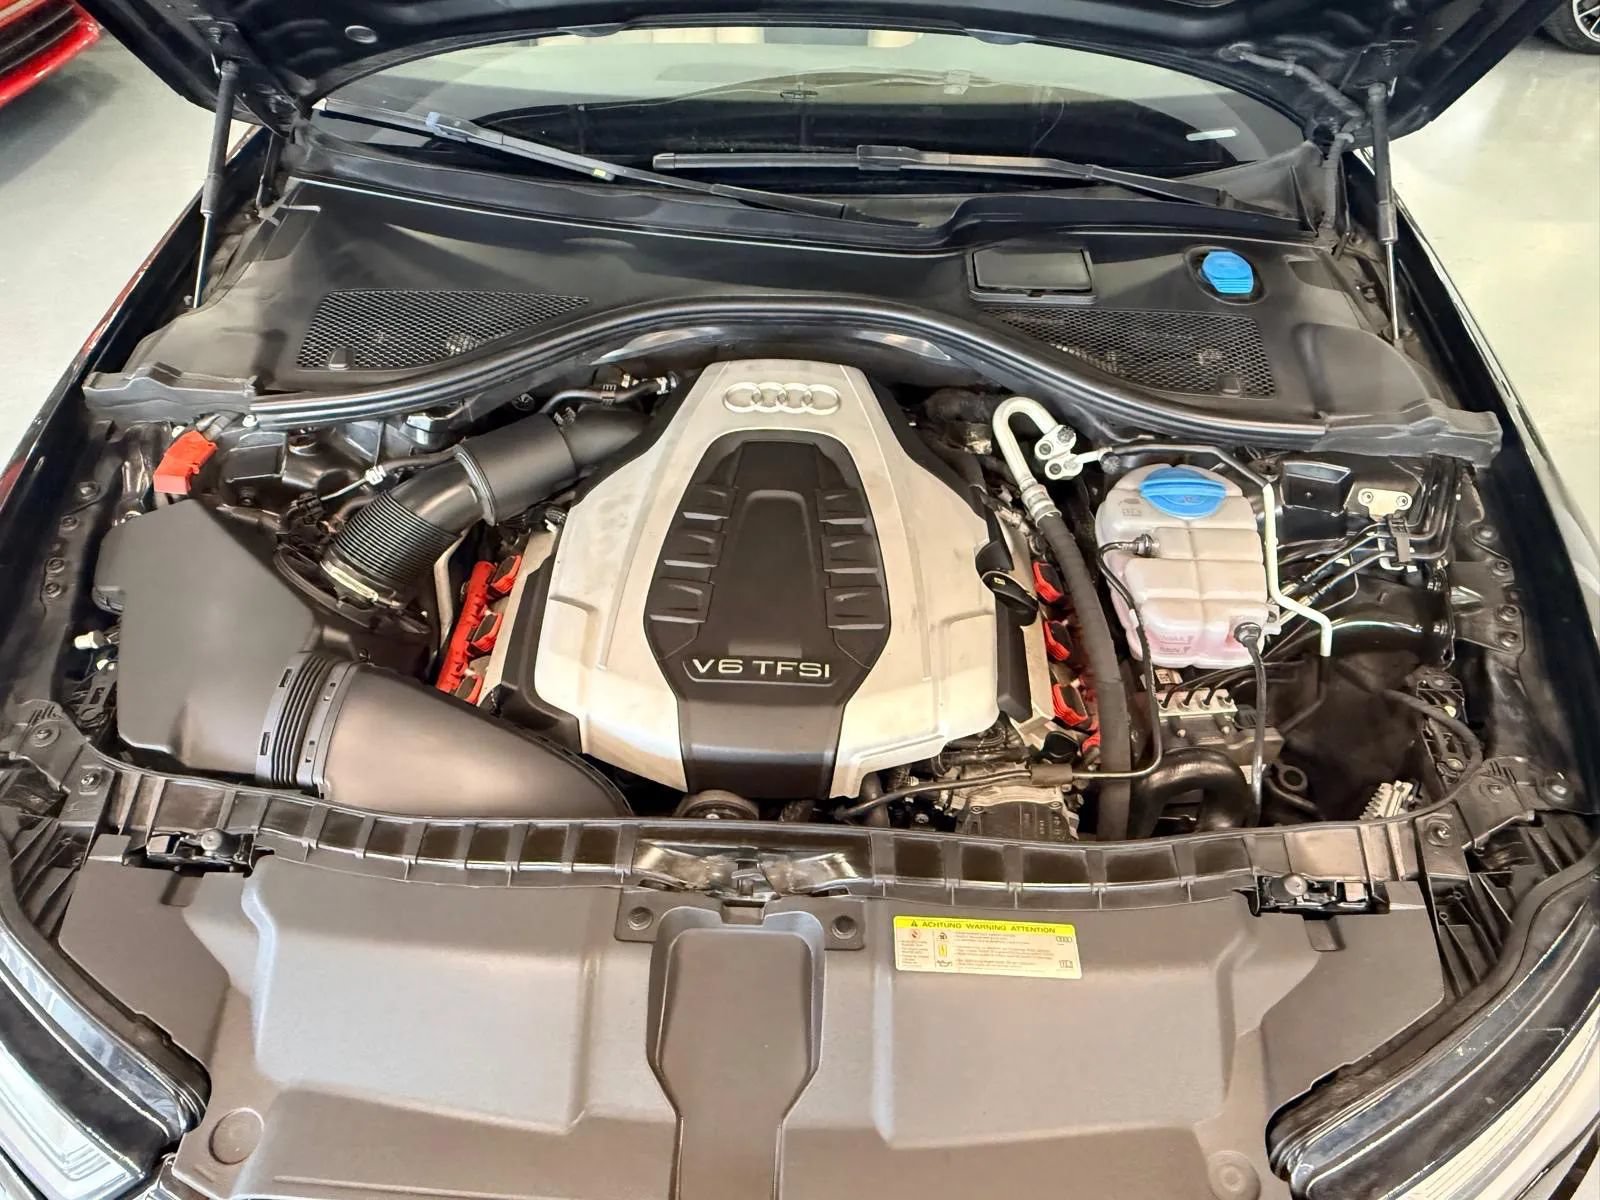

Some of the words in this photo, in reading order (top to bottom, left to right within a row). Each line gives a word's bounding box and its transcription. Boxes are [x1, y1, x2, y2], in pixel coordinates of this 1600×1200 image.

[692, 659, 743, 674] V6
[752, 660, 830, 678] TFSI
[922, 921, 962, 929] ACHTUNG
[966, 923, 1007, 931] WARNING
[1010, 925, 1056, 934] ATTENTION
